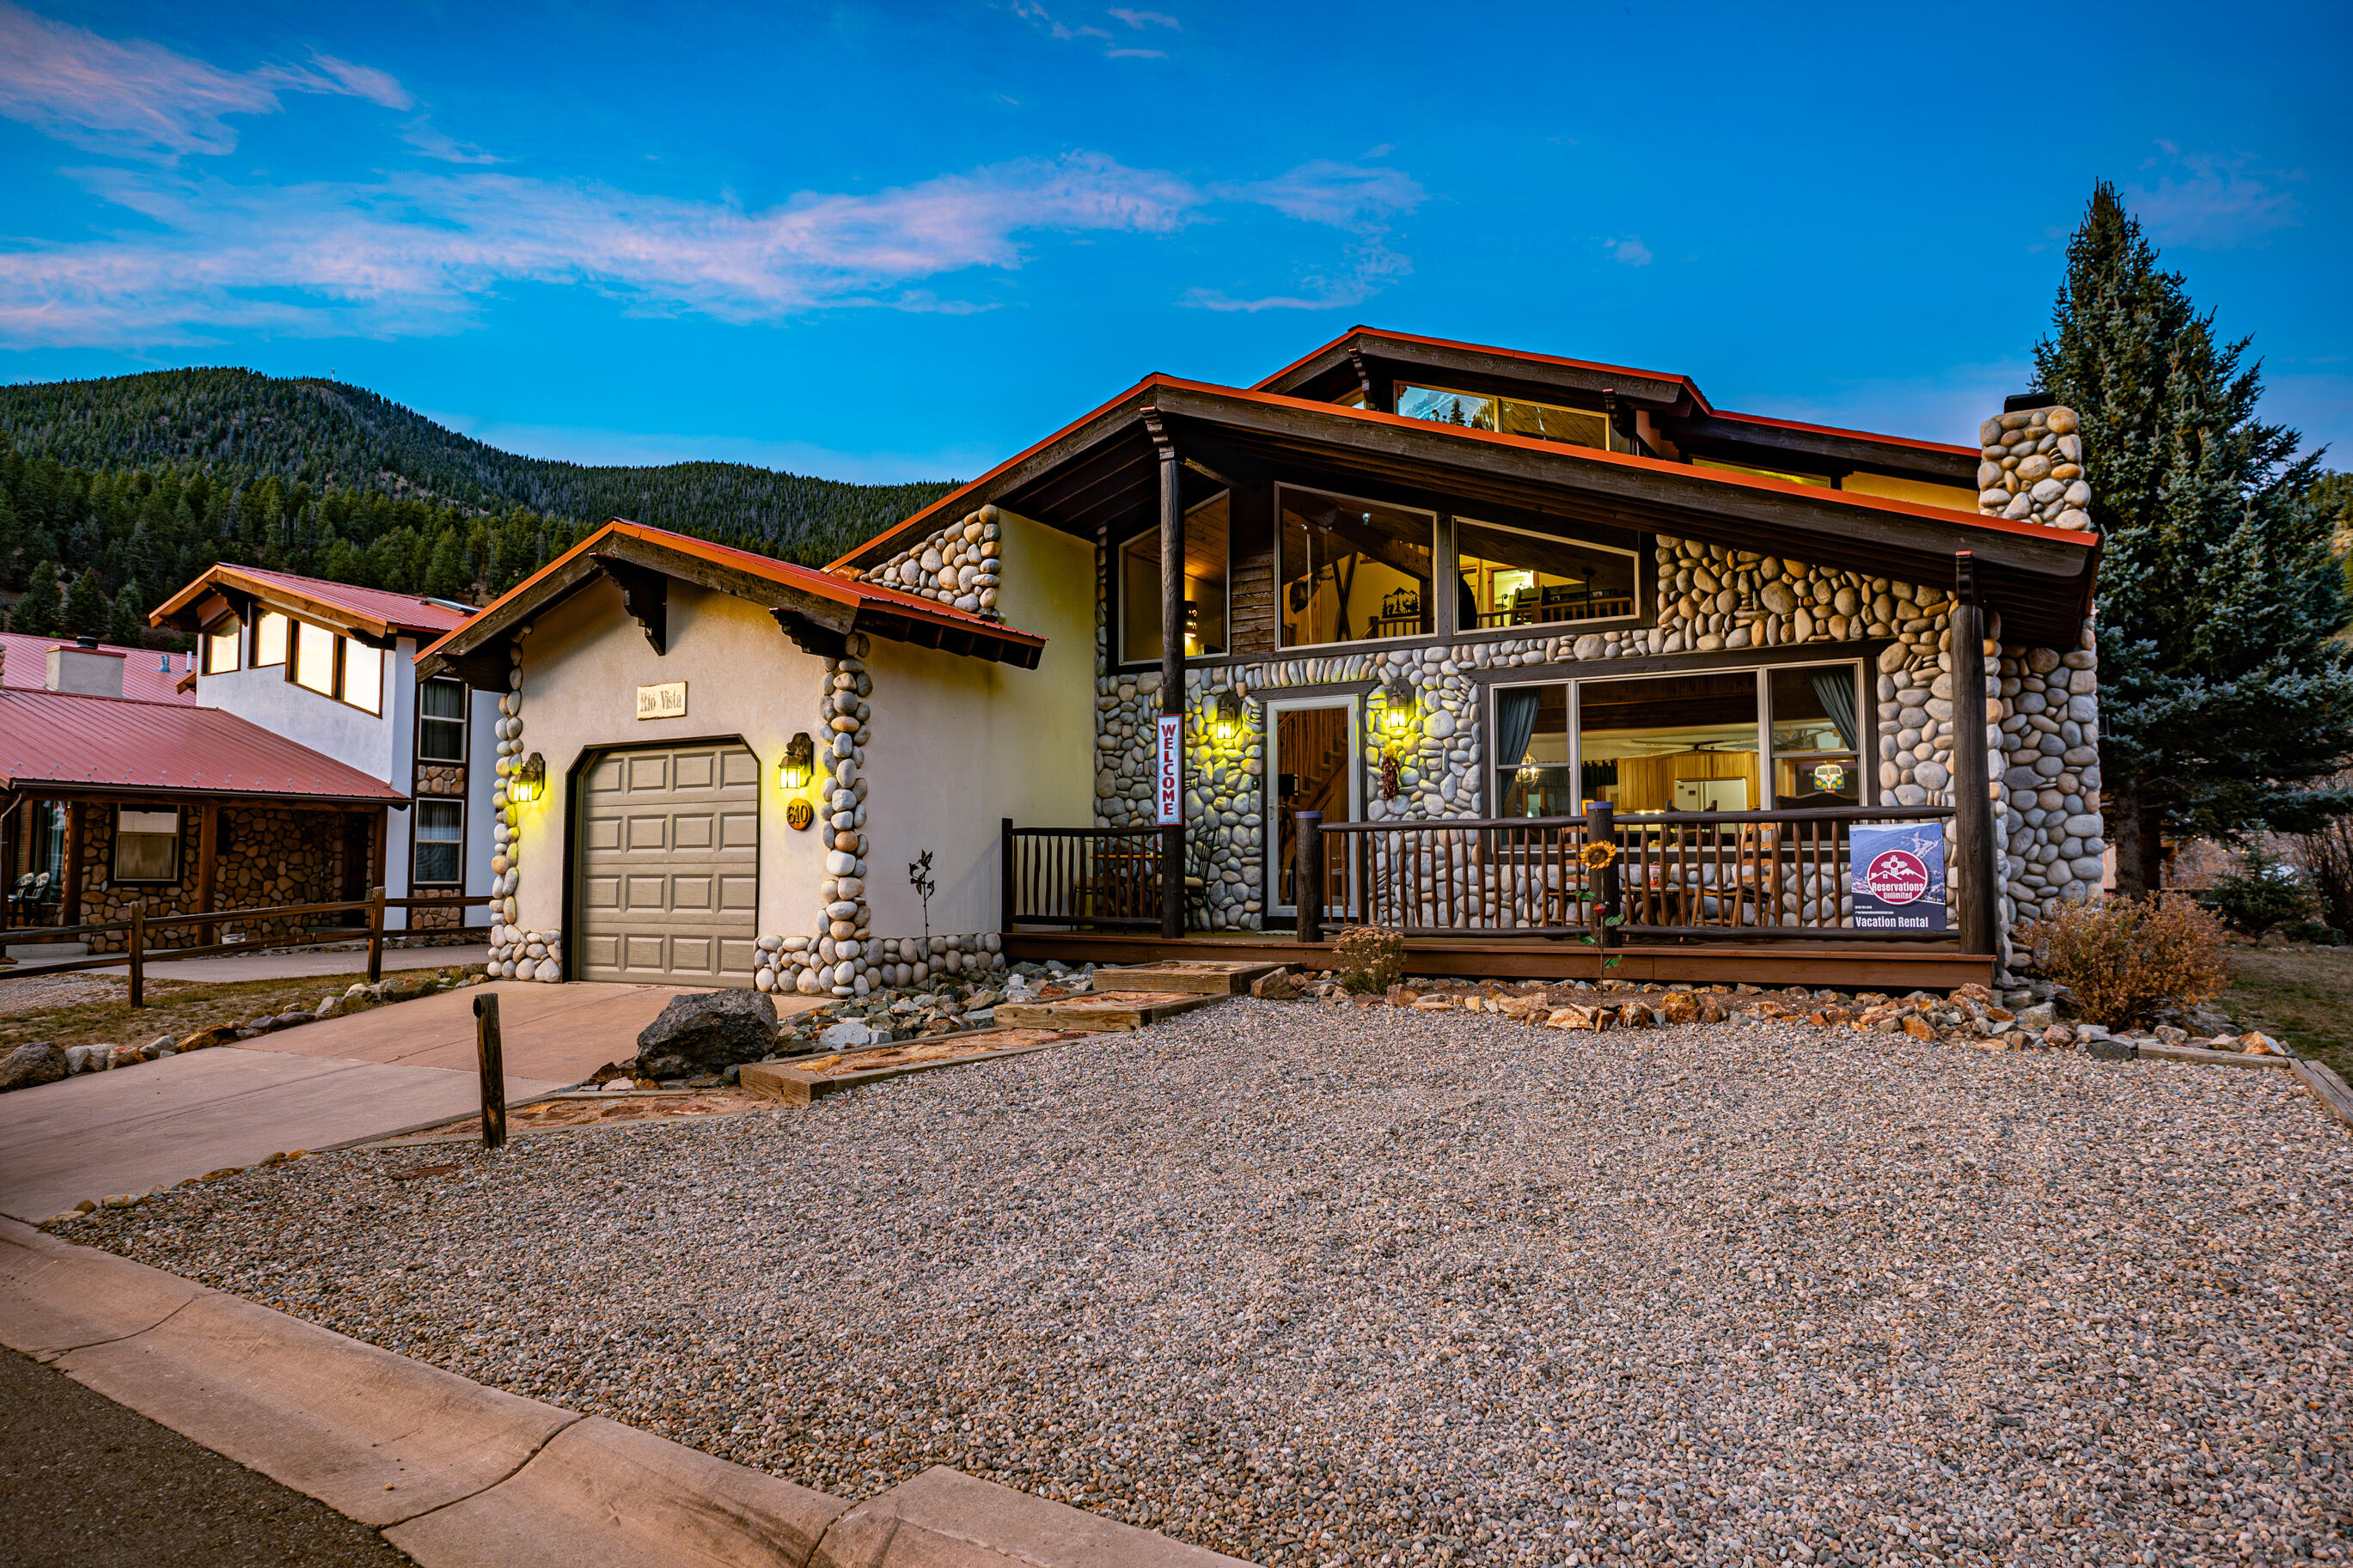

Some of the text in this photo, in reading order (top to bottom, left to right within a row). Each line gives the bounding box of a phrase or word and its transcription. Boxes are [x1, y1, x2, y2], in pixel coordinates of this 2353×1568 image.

[660, 690, 681, 710] Vista
[1161, 724, 1176, 815] WELCOME
[788, 805, 809, 823] 610
[1872, 882, 1923, 892] Reservations
[1855, 916, 1928, 928] Vacation Rental
